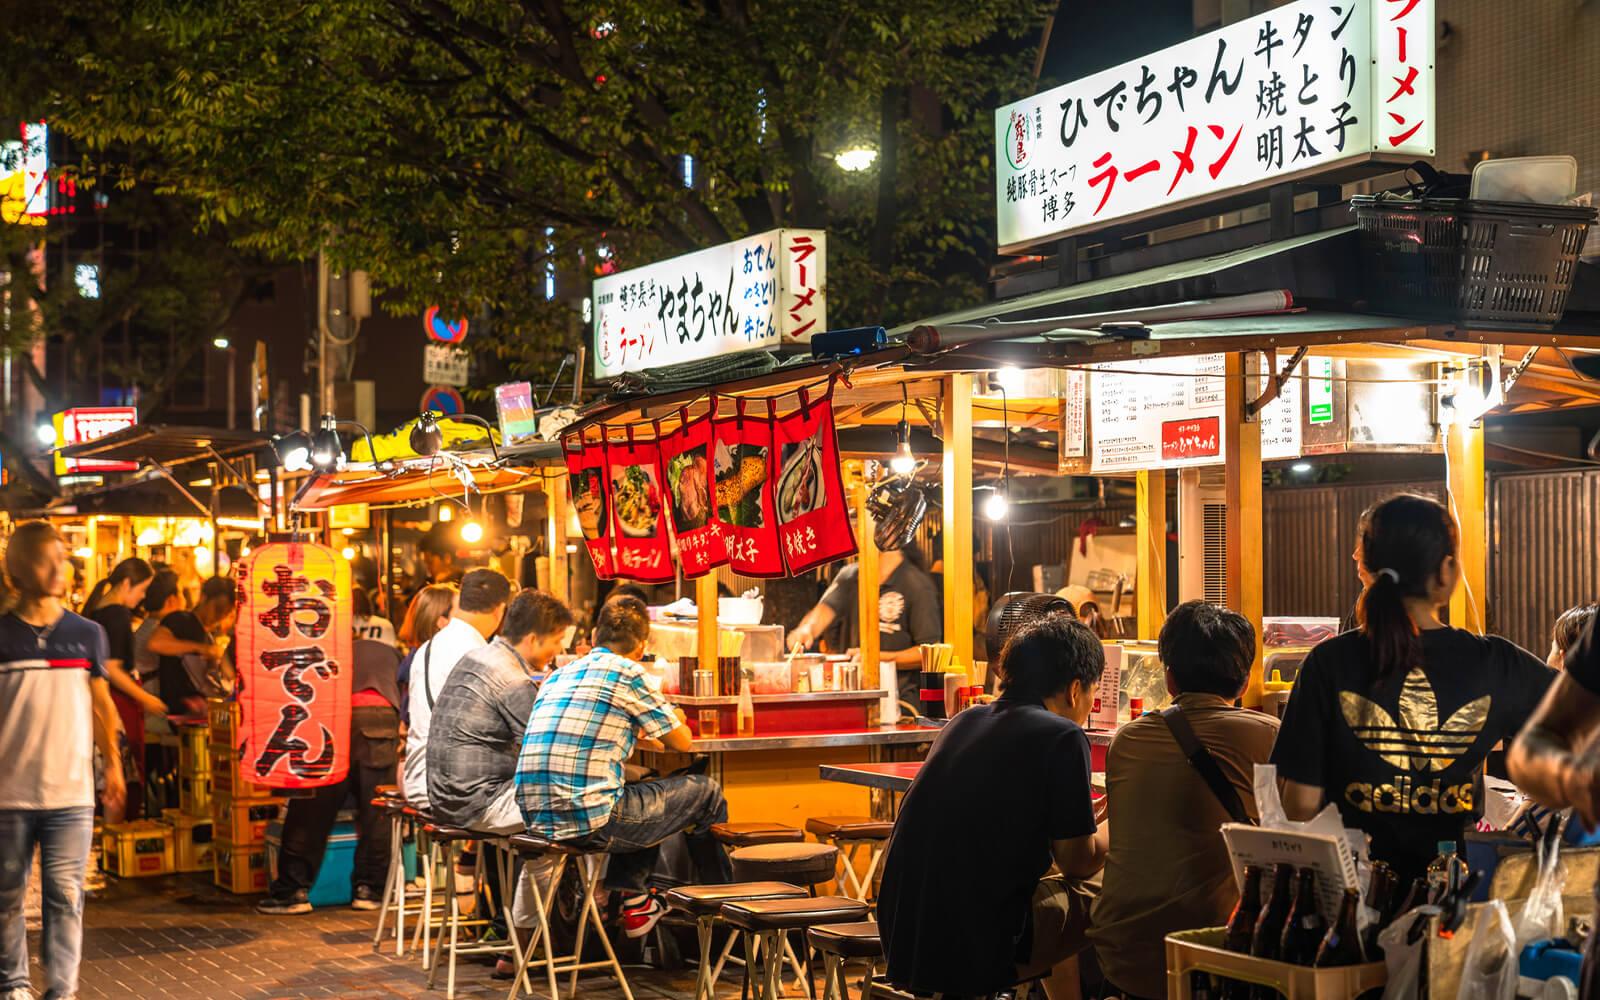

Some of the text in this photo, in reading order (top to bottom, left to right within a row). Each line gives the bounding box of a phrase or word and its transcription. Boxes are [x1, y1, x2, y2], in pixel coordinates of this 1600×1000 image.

[1254, 2, 1356, 69] 牛タン
[1060, 38, 1244, 147] ひでちゃん
[1255, 47, 1357, 121] 焼とり
[1087, 123, 1244, 216] ラーメン
[1256, 102, 1358, 171] 明太子
[1042, 190, 1075, 223] 博多
[743, 241, 775, 274] おでん
[789, 236, 816, 337] ラーメン
[657, 266, 739, 344] やまちゃん
[744, 277, 776, 307] やきとり
[744, 311, 776, 342] 牛たん
[725, 535, 759, 563] 明太子
[256, 565, 339, 779] おでん
[1345, 775, 1473, 815] adidas
